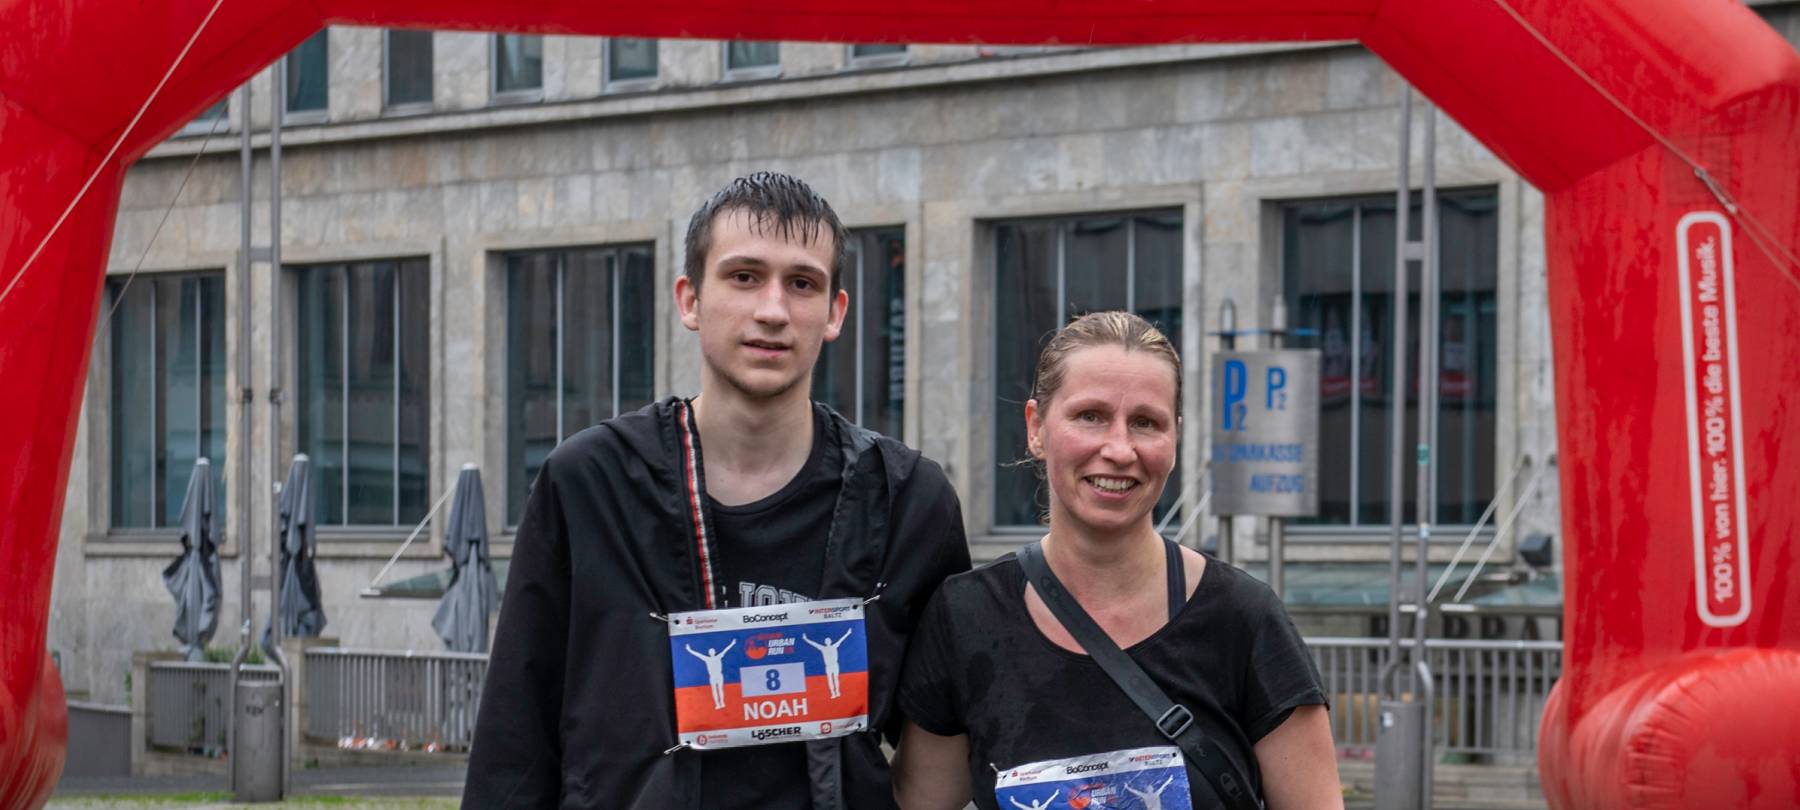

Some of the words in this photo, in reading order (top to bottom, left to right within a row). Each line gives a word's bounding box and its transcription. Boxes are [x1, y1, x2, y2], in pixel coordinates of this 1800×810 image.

[1696, 235, 1718, 302] Musik.
[1702, 304, 1721, 361] beste
[1703, 364, 1723, 394] die
[1705, 396, 1726, 456] 100%
[1710, 457, 1729, 500] hier.
[1715, 503, 1730, 539] von
[1713, 542, 1734, 603] 100%
[742, 612, 788, 623] BoConcept
[768, 638, 795, 647] URBAN
[768, 647, 784, 656] RUN
[765, 669, 780, 690] 8
[744, 699, 808, 720] NOAH
[1066, 761, 1109, 774] BoConcept
